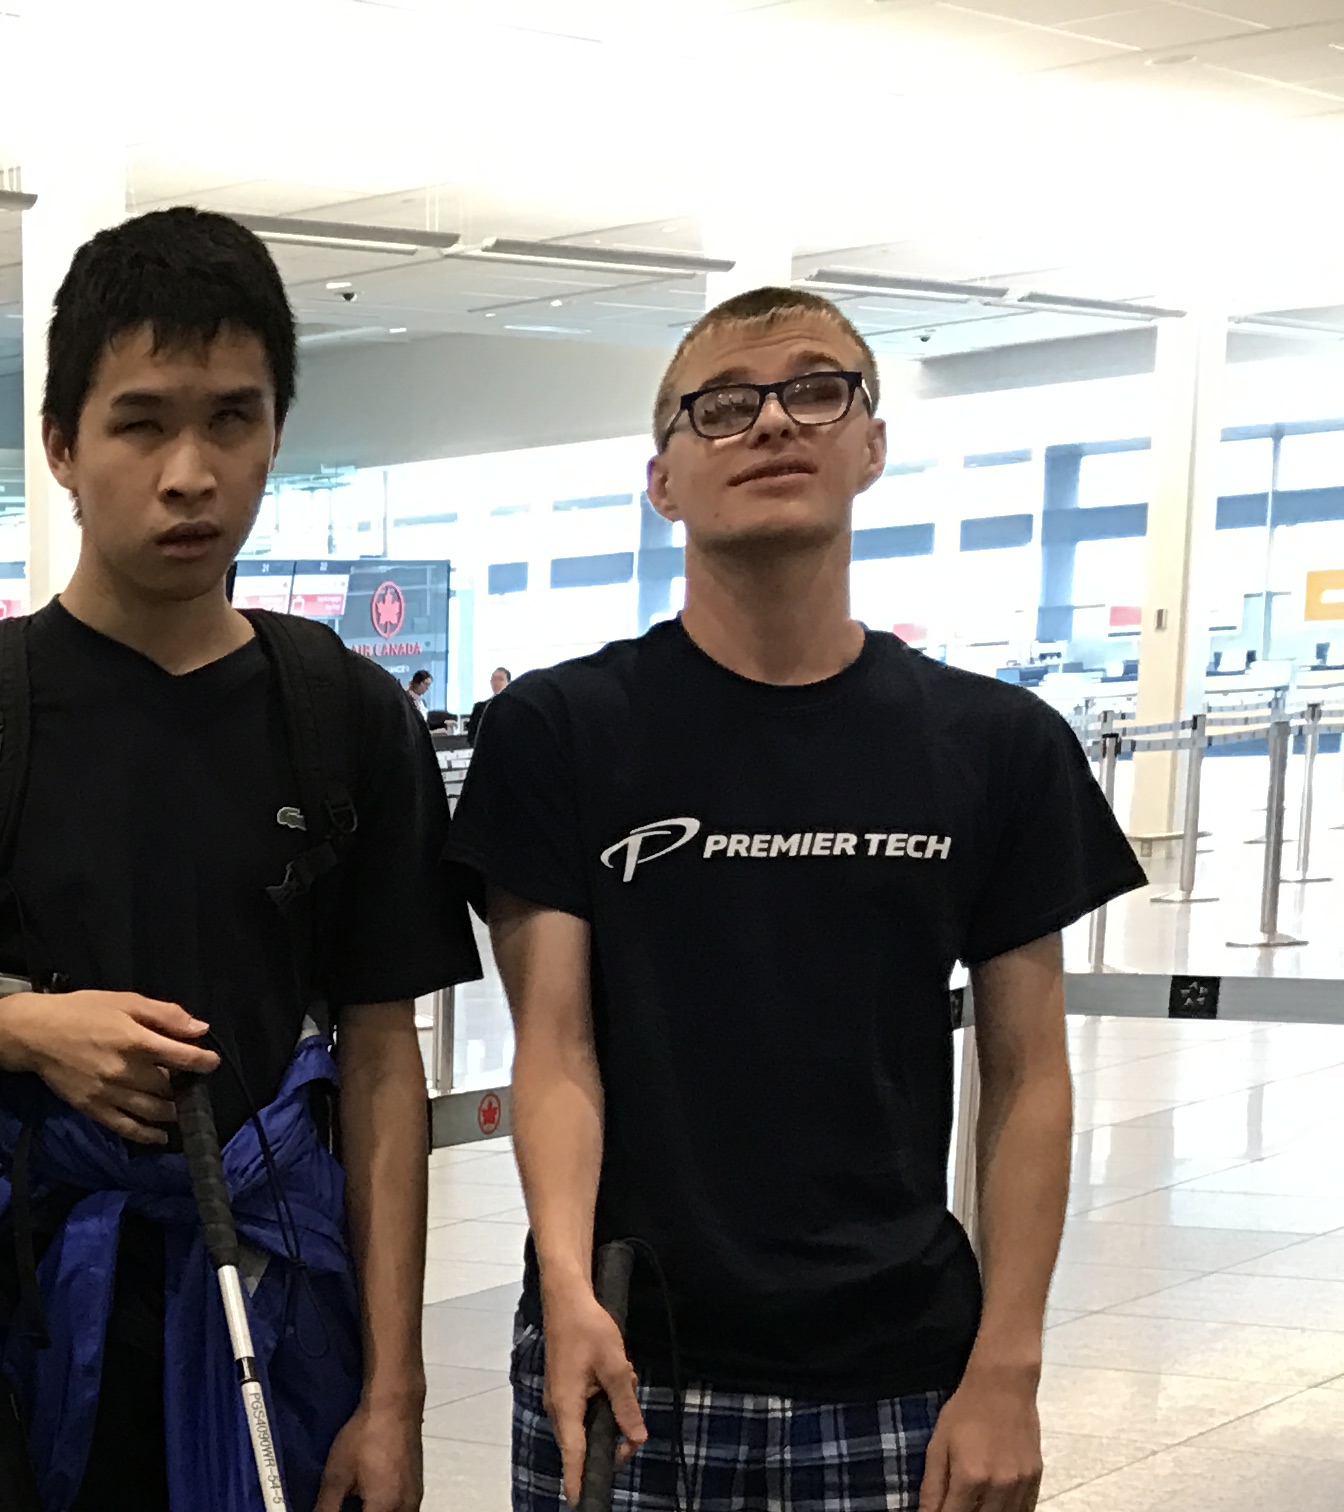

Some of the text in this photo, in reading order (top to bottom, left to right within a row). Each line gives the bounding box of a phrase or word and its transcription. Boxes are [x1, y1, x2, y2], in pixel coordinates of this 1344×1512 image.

[375, 642, 422, 657] CANADA
[702, 832, 858, 859] PREMIER
[864, 832, 952, 860] TECH
